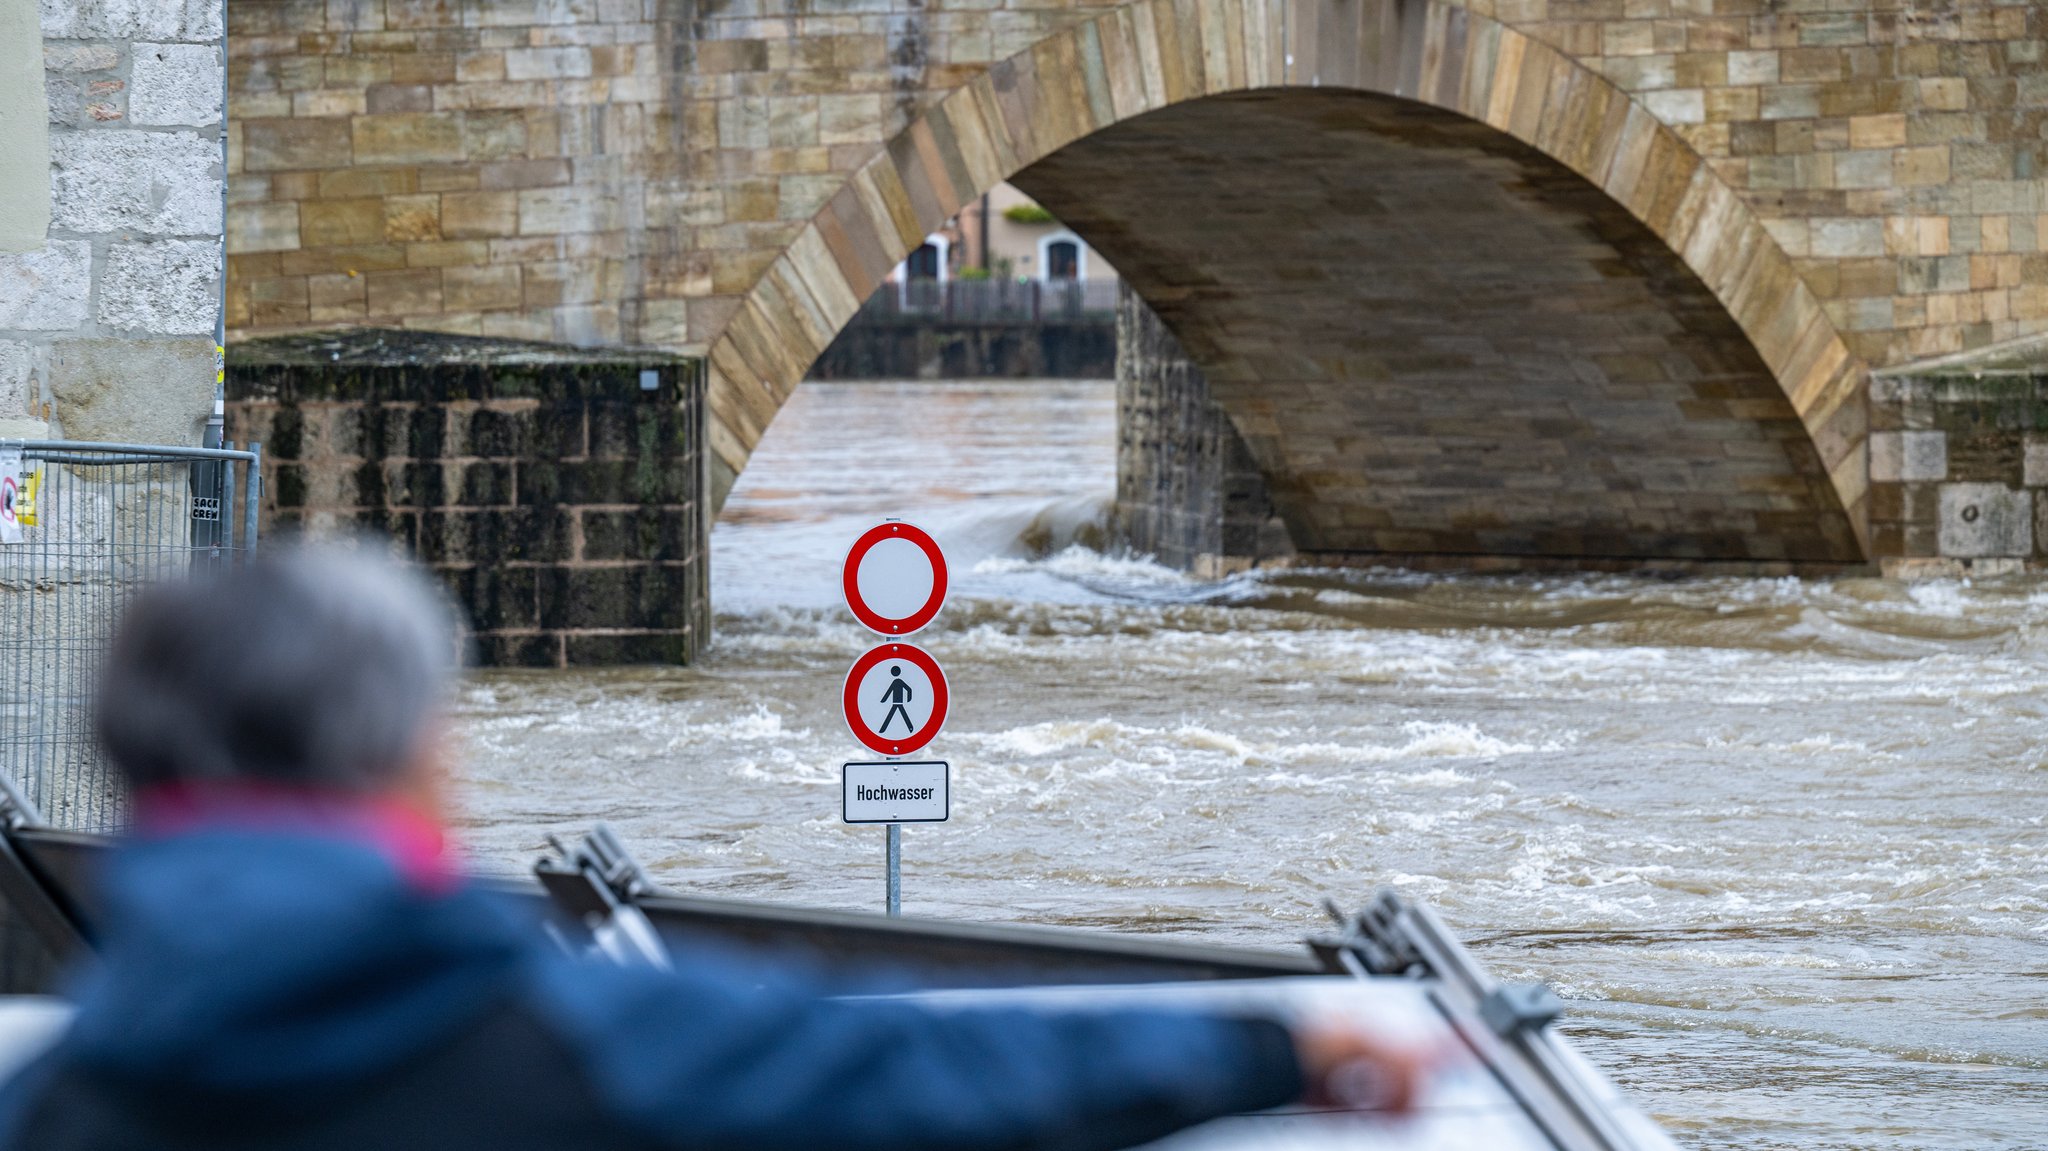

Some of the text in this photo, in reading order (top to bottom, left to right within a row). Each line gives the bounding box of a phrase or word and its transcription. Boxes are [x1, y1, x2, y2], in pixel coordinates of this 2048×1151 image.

[194, 498, 218, 508] SACK
[193, 509, 218, 519] CREW
[857, 785, 934, 801] Hochwasser
